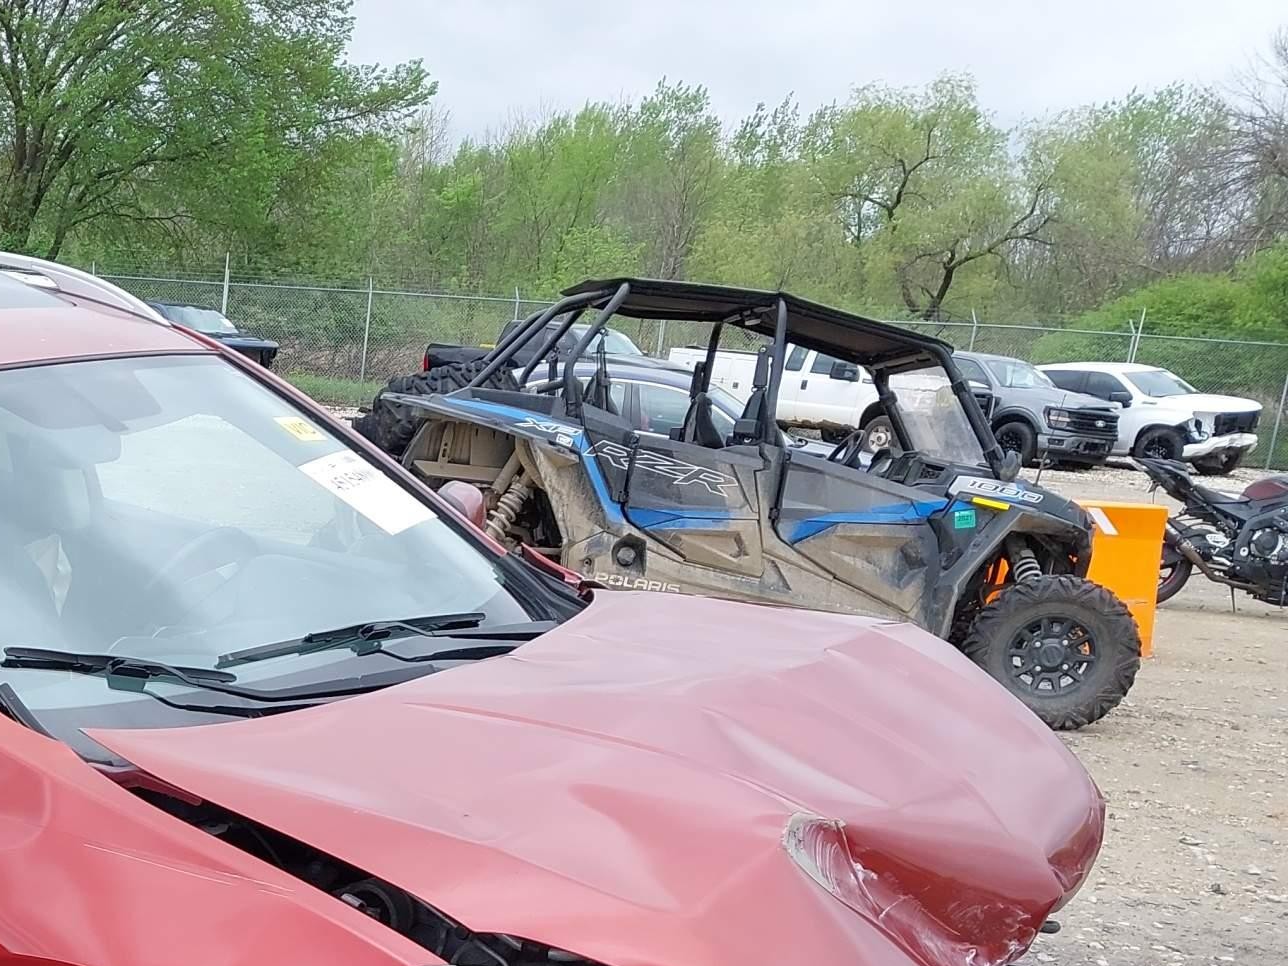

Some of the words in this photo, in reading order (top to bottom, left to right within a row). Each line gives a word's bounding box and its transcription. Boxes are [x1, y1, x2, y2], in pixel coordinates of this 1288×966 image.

[514, 417, 584, 436] XP
[582, 439, 739, 498] RZR
[968, 480, 1044, 504] 1000
[594, 571, 681, 593] POLARIS
